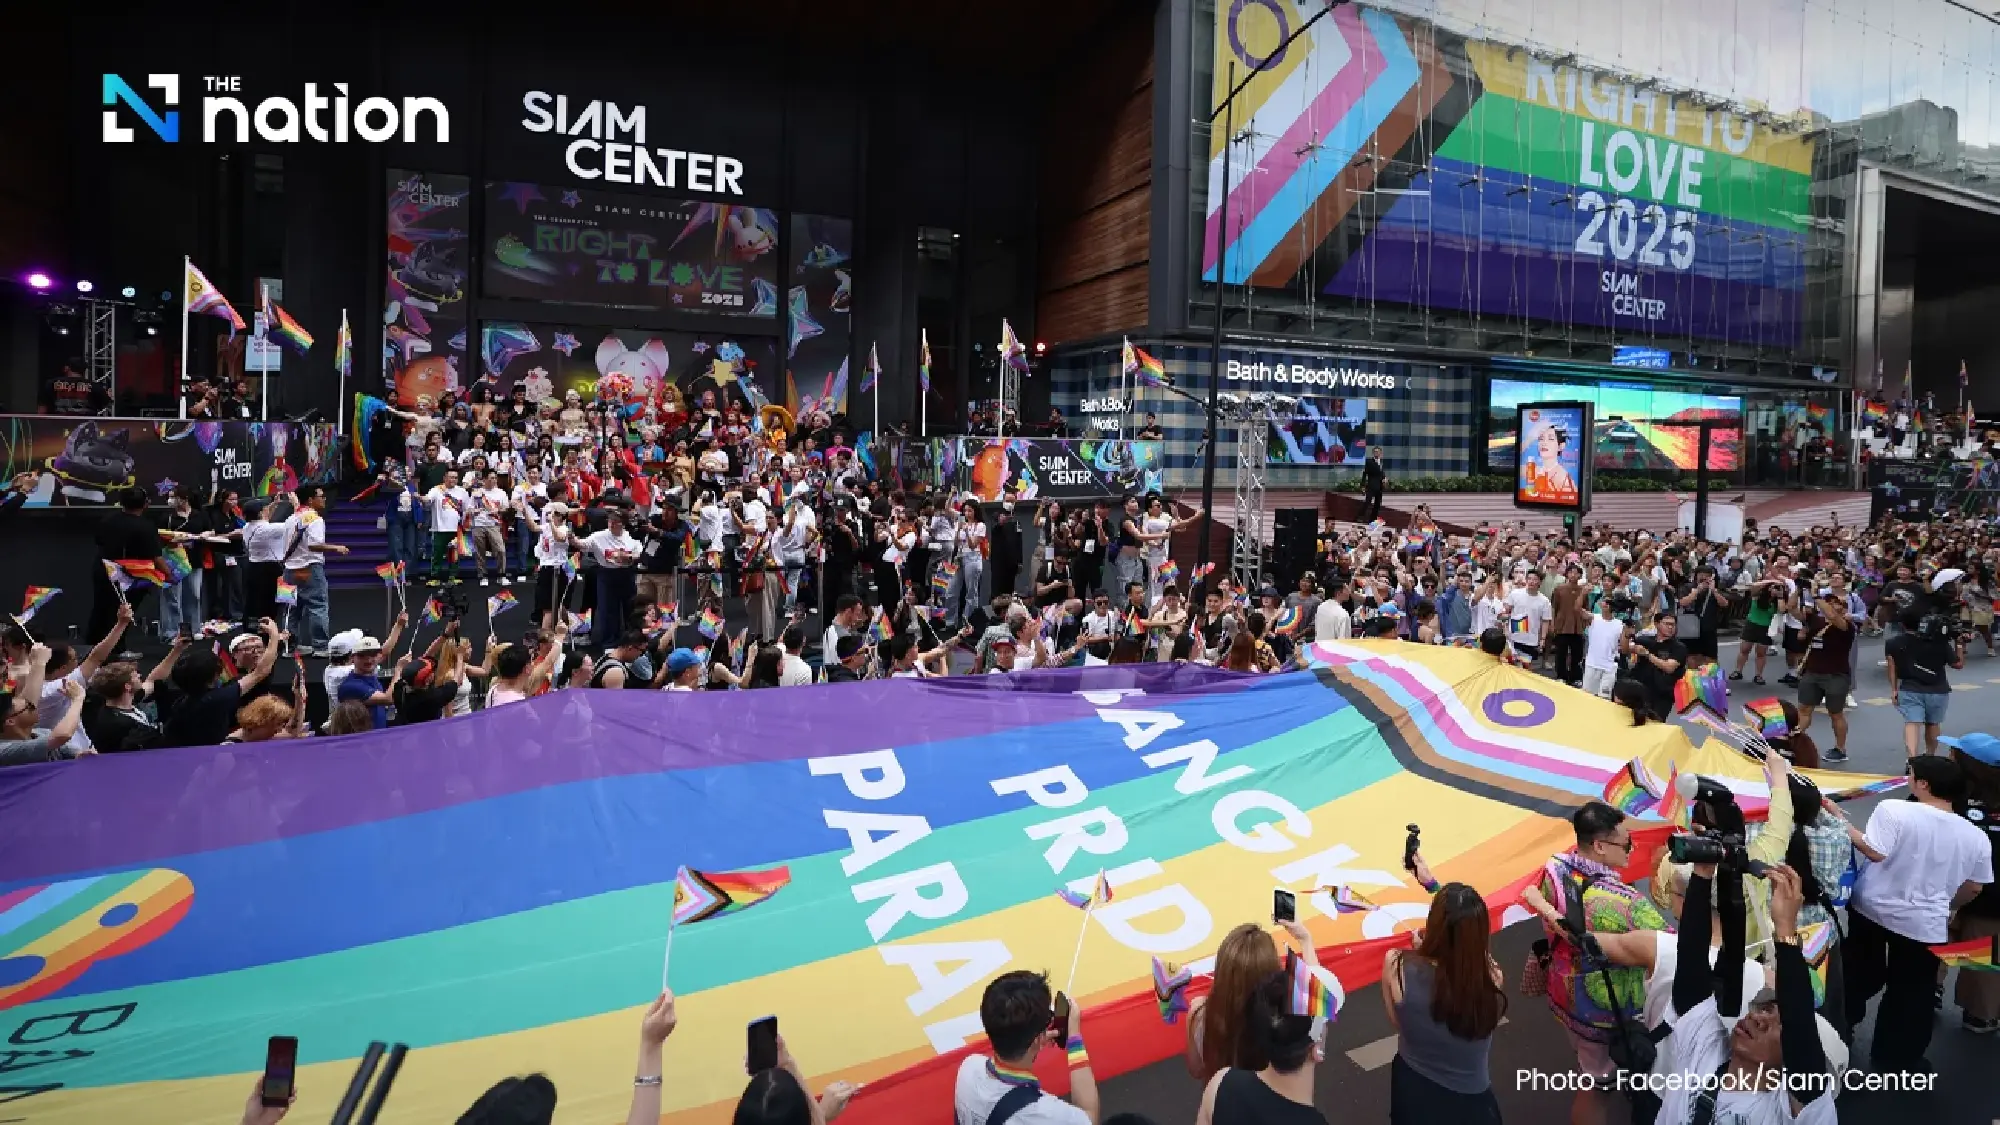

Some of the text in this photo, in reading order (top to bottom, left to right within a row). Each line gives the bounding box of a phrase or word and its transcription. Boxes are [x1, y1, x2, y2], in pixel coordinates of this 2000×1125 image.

[522, 90, 646, 144] SIAM
[565, 138, 744, 196] CENTER
[1579, 121, 1706, 209] LOVE
[397, 180, 432, 194] SIAM
[408, 193, 459, 207] CENTER
[535, 223, 658, 260] RIGHT
[1574, 190, 1698, 270] 2025
[596, 259, 744, 291] TO LOVE
[1601, 270, 1638, 293] SIAM
[1611, 294, 1666, 321] CENTER
[1226, 359, 1272, 383] Bath
[1273, 362, 1289, 384] &
[1291, 364, 1339, 389] Body
[1340, 367, 1395, 389] Works
[1091, 416, 1119, 431] Works
[214, 448, 236, 465] SIAM
[1039, 455, 1069, 470] SIAM
[222, 462, 251, 480] CENTER
[1050, 469, 1092, 485] CENTER
